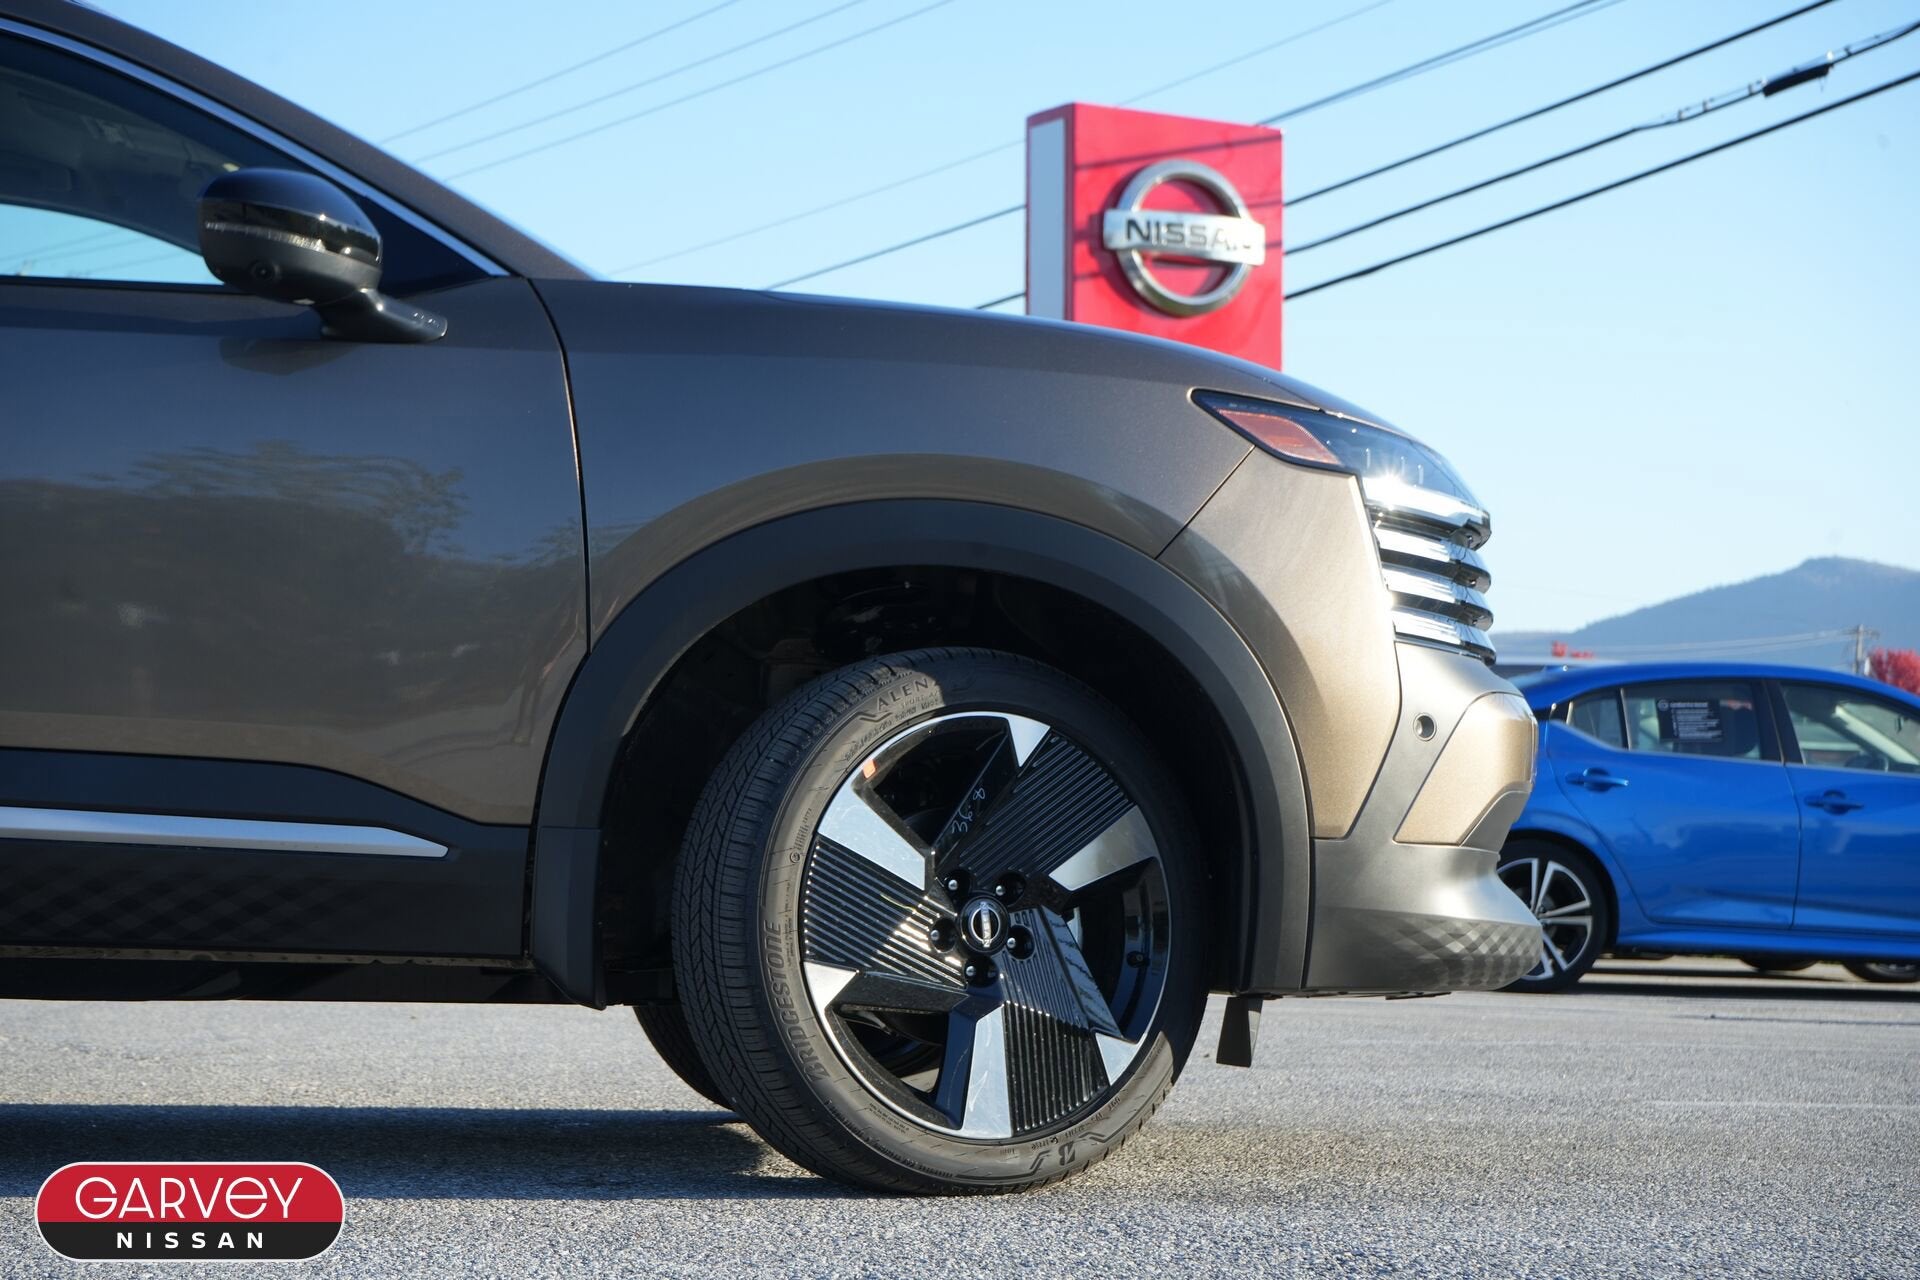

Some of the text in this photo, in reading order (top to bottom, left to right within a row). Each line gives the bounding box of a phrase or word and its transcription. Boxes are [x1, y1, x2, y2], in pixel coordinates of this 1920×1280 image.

[1125, 218, 1253, 250] NISSA
[877, 678, 930, 711] ALEN
[763, 919, 831, 1082] BRIDGESTONE
